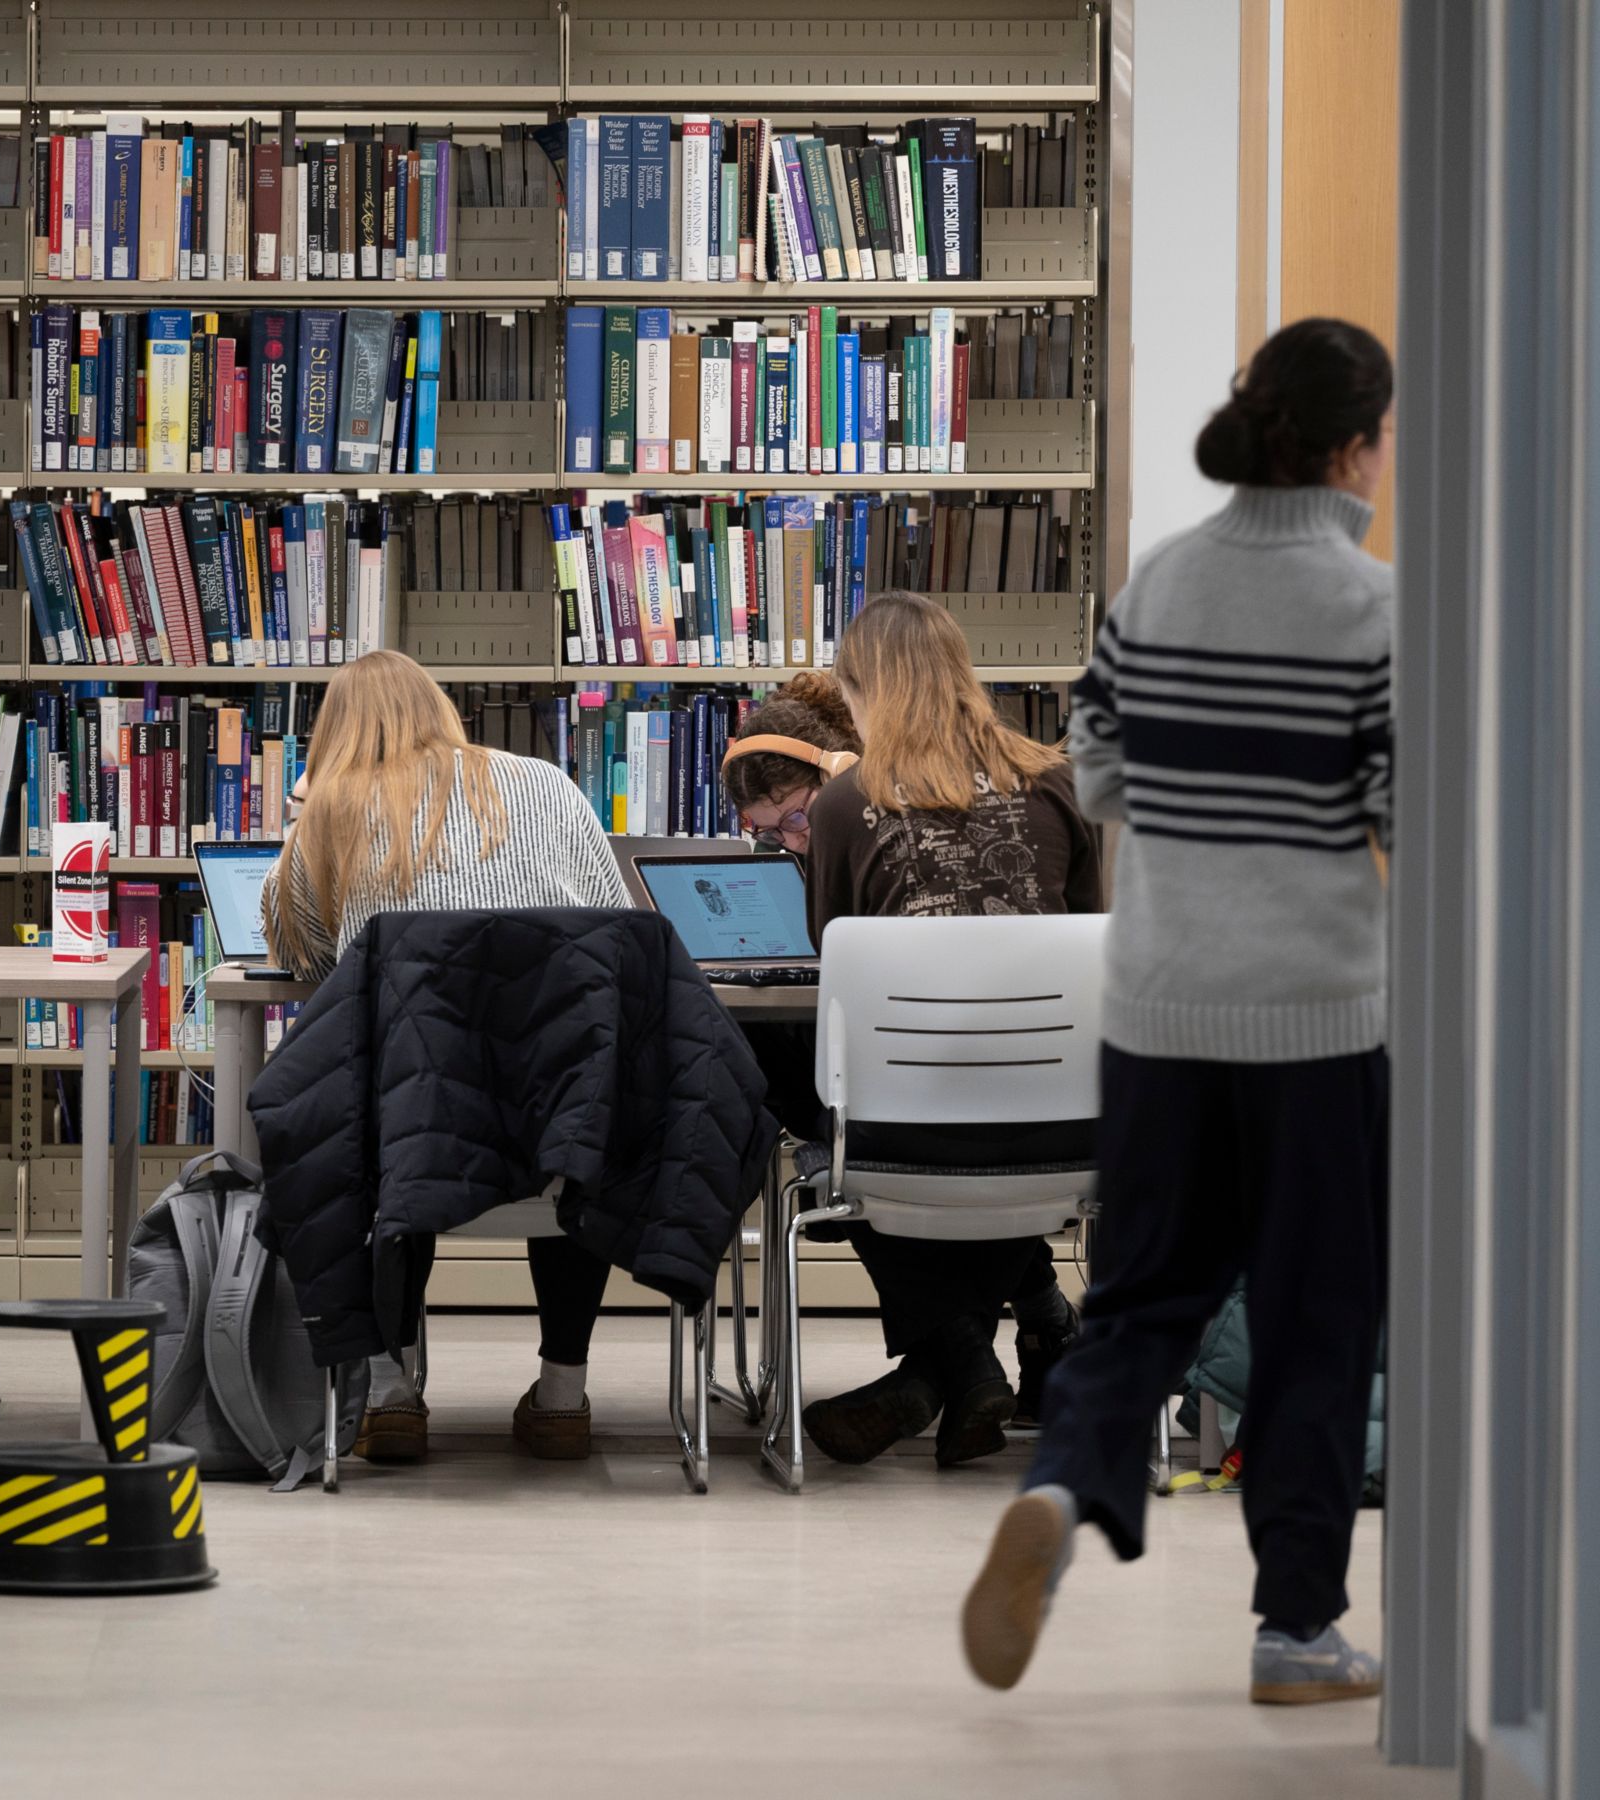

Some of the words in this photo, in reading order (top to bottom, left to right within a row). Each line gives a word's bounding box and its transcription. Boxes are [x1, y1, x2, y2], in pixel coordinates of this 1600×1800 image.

[685, 126, 706, 134] ASCP
[158, 146, 168, 172] Surgery
[574, 140, 582, 160] Manual
[816, 148, 824, 162] THE
[312, 161, 321, 183] DRUIN
[329, 166, 337, 182] One
[604, 164, 613, 208] PATHOLOGY
[612, 164, 621, 200] SURGICAL
[620, 164, 630, 198] MODERN
[637, 165, 646, 209] PATHOLOGY
[645, 165, 654, 201] SURGICAL
[654, 165, 663, 200] MODERN
[792, 171, 804, 203] Anesthesia
[806, 148, 823, 206] ANAESTHESIA
[817, 164, 828, 194] HISTORY
[312, 185, 320, 207] BURCH
[693, 179, 702, 247] COMPANION
[822, 196, 830, 206] OF
[943, 168, 960, 253] ANESTHESIOLOGY
[796, 203, 810, 236] Equipment
[47, 338, 60, 386] Robotic
[59, 340, 68, 354] The
[392, 336, 400, 362] SURGERY
[648, 343, 658, 382] Clinical
[59, 356, 68, 393] Foundation
[85, 360, 94, 394] Essential
[191, 352, 200, 386] SKILLS
[354, 348, 369, 416] SURGERY
[610, 351, 620, 418] ANESTHESIA
[620, 360, 630, 410] CLINICAL
[712, 363, 720, 400] CLINICAL
[740, 368, 748, 392] Basics
[59, 394, 67, 408] and
[115, 377, 124, 406] General
[192, 388, 199, 400] IN
[224, 384, 233, 414] Surgery
[266, 364, 286, 434] Surgery
[309, 346, 332, 438] SURGERY
[704, 363, 712, 434] ANESTHESIOLOGY
[740, 394, 748, 404] of
[776, 385, 784, 426] Textbook
[44, 388, 60, 436] Surgery
[58, 413, 66, 426] Art
[82, 396, 92, 434] Surgery
[113, 407, 123, 436] Surgery
[190, 402, 199, 448] SURGERY
[648, 384, 657, 434] Anesthesia
[740, 404, 748, 442] Anesthesia
[768, 385, 776, 442] Anaesthesia
[58, 426, 66, 436] of
[776, 428, 784, 438] of
[81, 515, 92, 540] LANGE
[192, 508, 214, 516] Phippen
[196, 514, 212, 522] Wells
[38, 538, 54, 586] TECHNIQUE
[42, 522, 58, 566] OPERATING
[52, 566, 63, 596] ROOM
[222, 536, 232, 565] Principles
[246, 538, 254, 572] Perioperative
[756, 542, 764, 572] Regional
[94, 574, 104, 598] SURGERY
[197, 562, 212, 613] PRACTICE
[206, 564, 219, 610] NURSING
[212, 546, 229, 625] PERIOPERATIVE
[309, 556, 318, 602] Laparoscopic
[314, 556, 324, 596] Endoscopic
[587, 548, 599, 594] ANESTHESIA
[645, 548, 662, 625] ANESTHESIOLOGY
[226, 573, 236, 612] Perioperative
[617, 562, 632, 628] ANESTHESIOLOGY
[231, 612, 239, 636] Practice
[310, 602, 319, 629] Surgery
[566, 594, 576, 630] ANESTHESIOLOGY
[586, 728, 594, 772] Intravenous
[88, 746, 99, 802] Micrographic
[162, 788, 172, 820] Surgery
[227, 784, 236, 808] Learning
[251, 790, 256, 798] ON
[934, 854, 948, 862] ALL
[948, 852, 958, 860] MY
[960, 850, 976, 858] LOVE
[58, 875, 76, 884] Silent
[76, 876, 92, 886] Zone
[906, 894, 957, 912] HOMESICK
